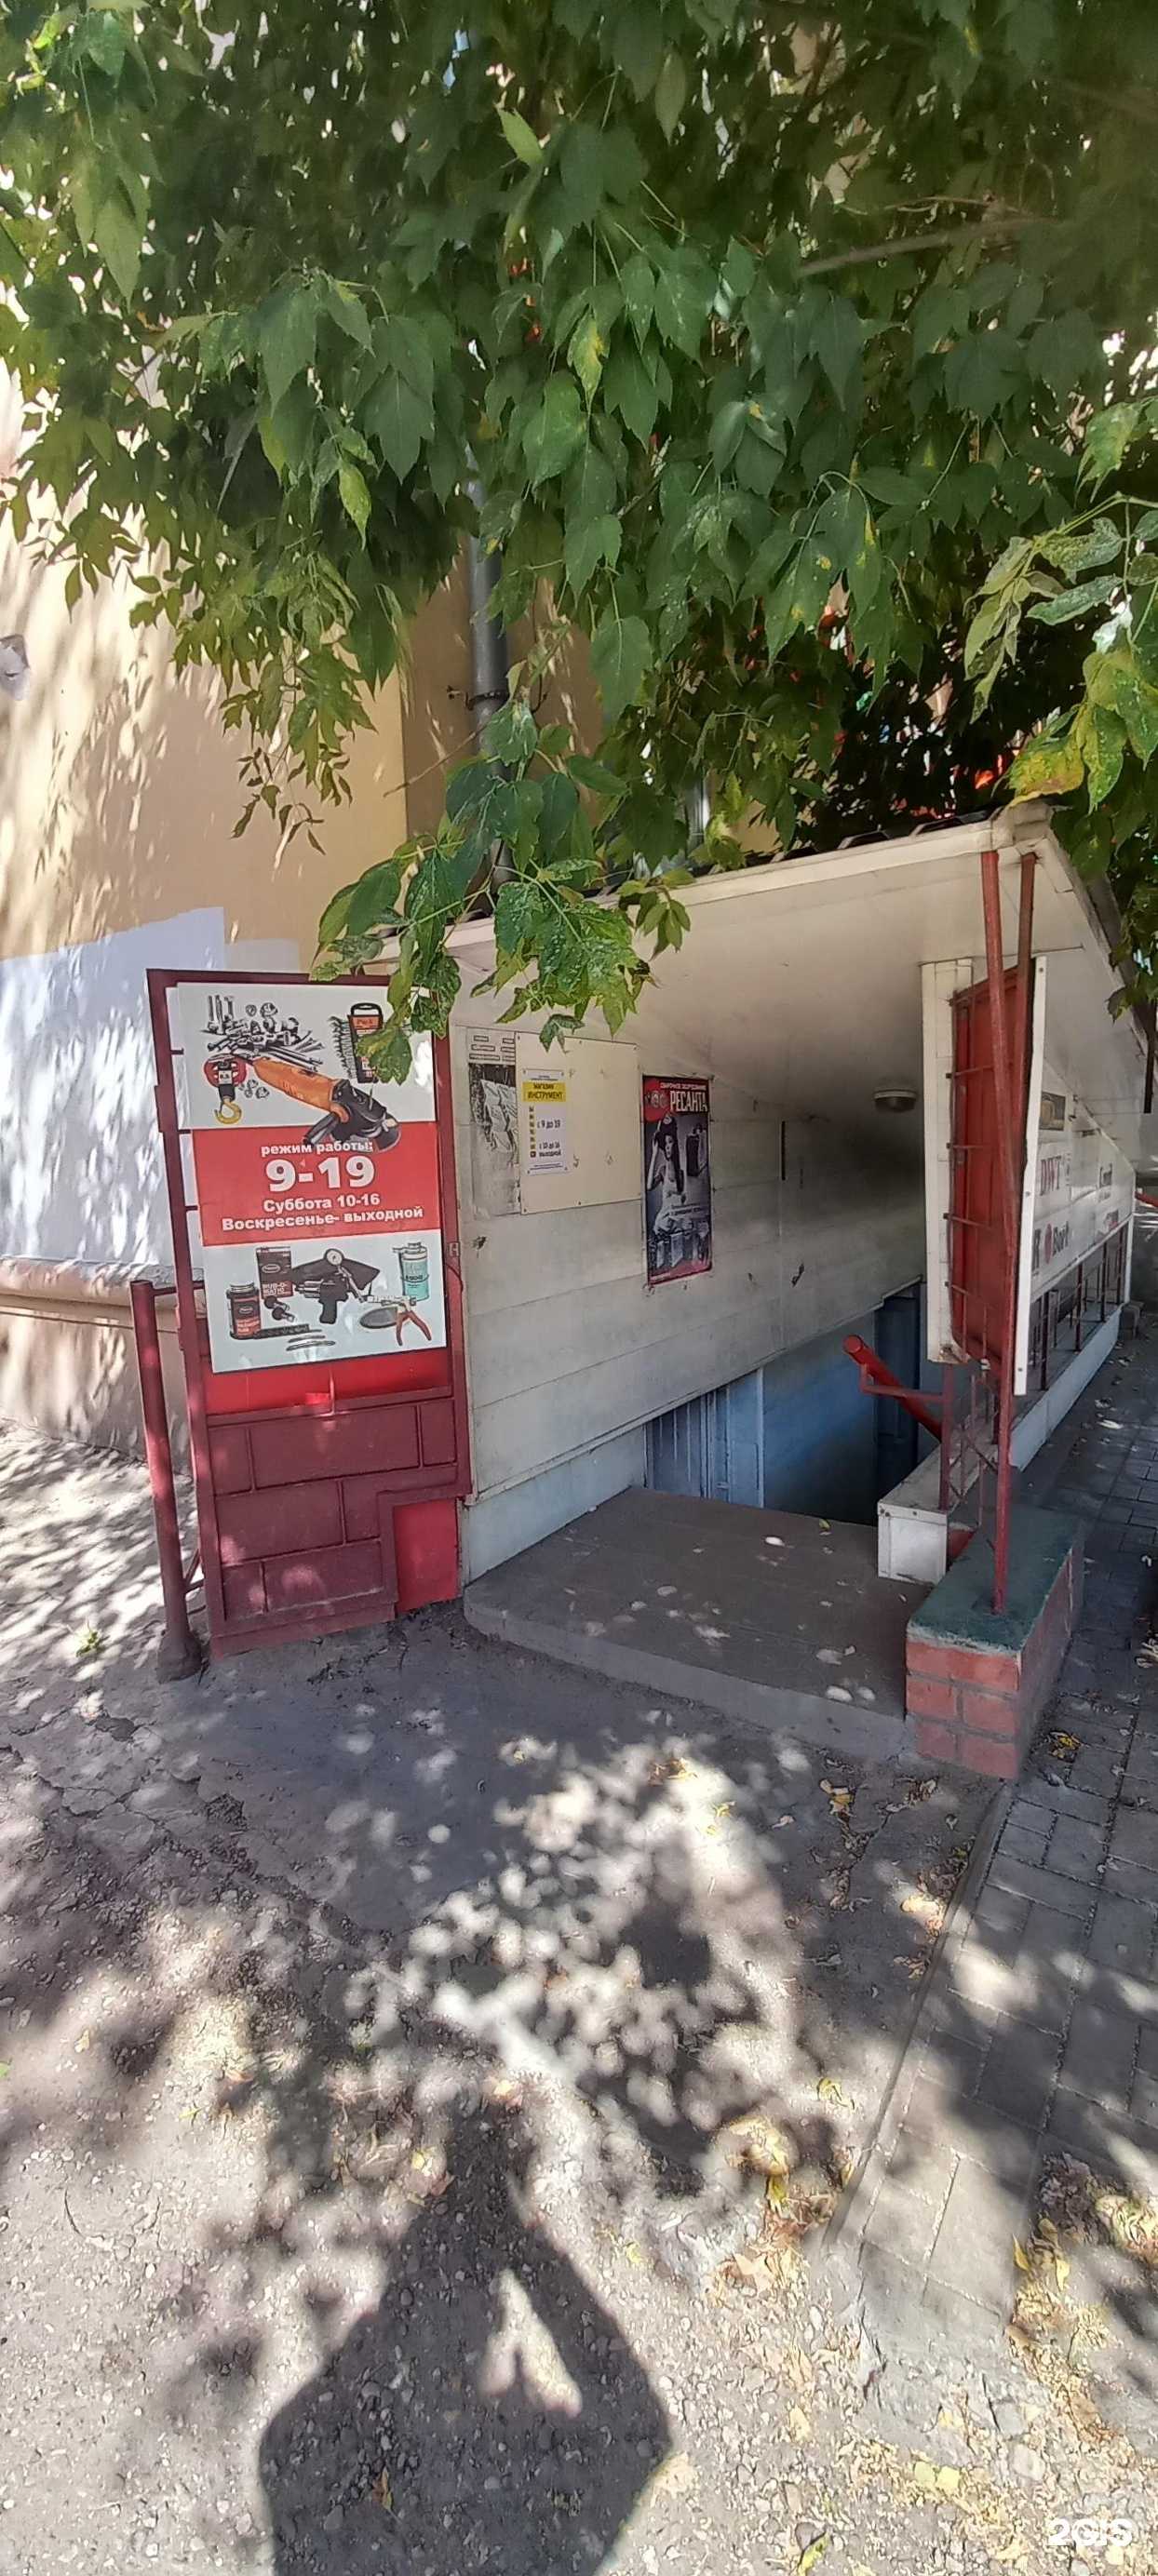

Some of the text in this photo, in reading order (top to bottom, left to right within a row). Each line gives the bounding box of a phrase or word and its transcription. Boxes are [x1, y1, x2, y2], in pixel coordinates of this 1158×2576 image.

[669, 1090, 708, 1113] РЕСАНТА
[261, 1141, 373, 1158] режим работы:
[265, 1155, 375, 1192] 9-19
[263, 1193, 381, 1214] Суббота 10-16
[222, 1206, 424, 1231] Воскресенье- выходной
